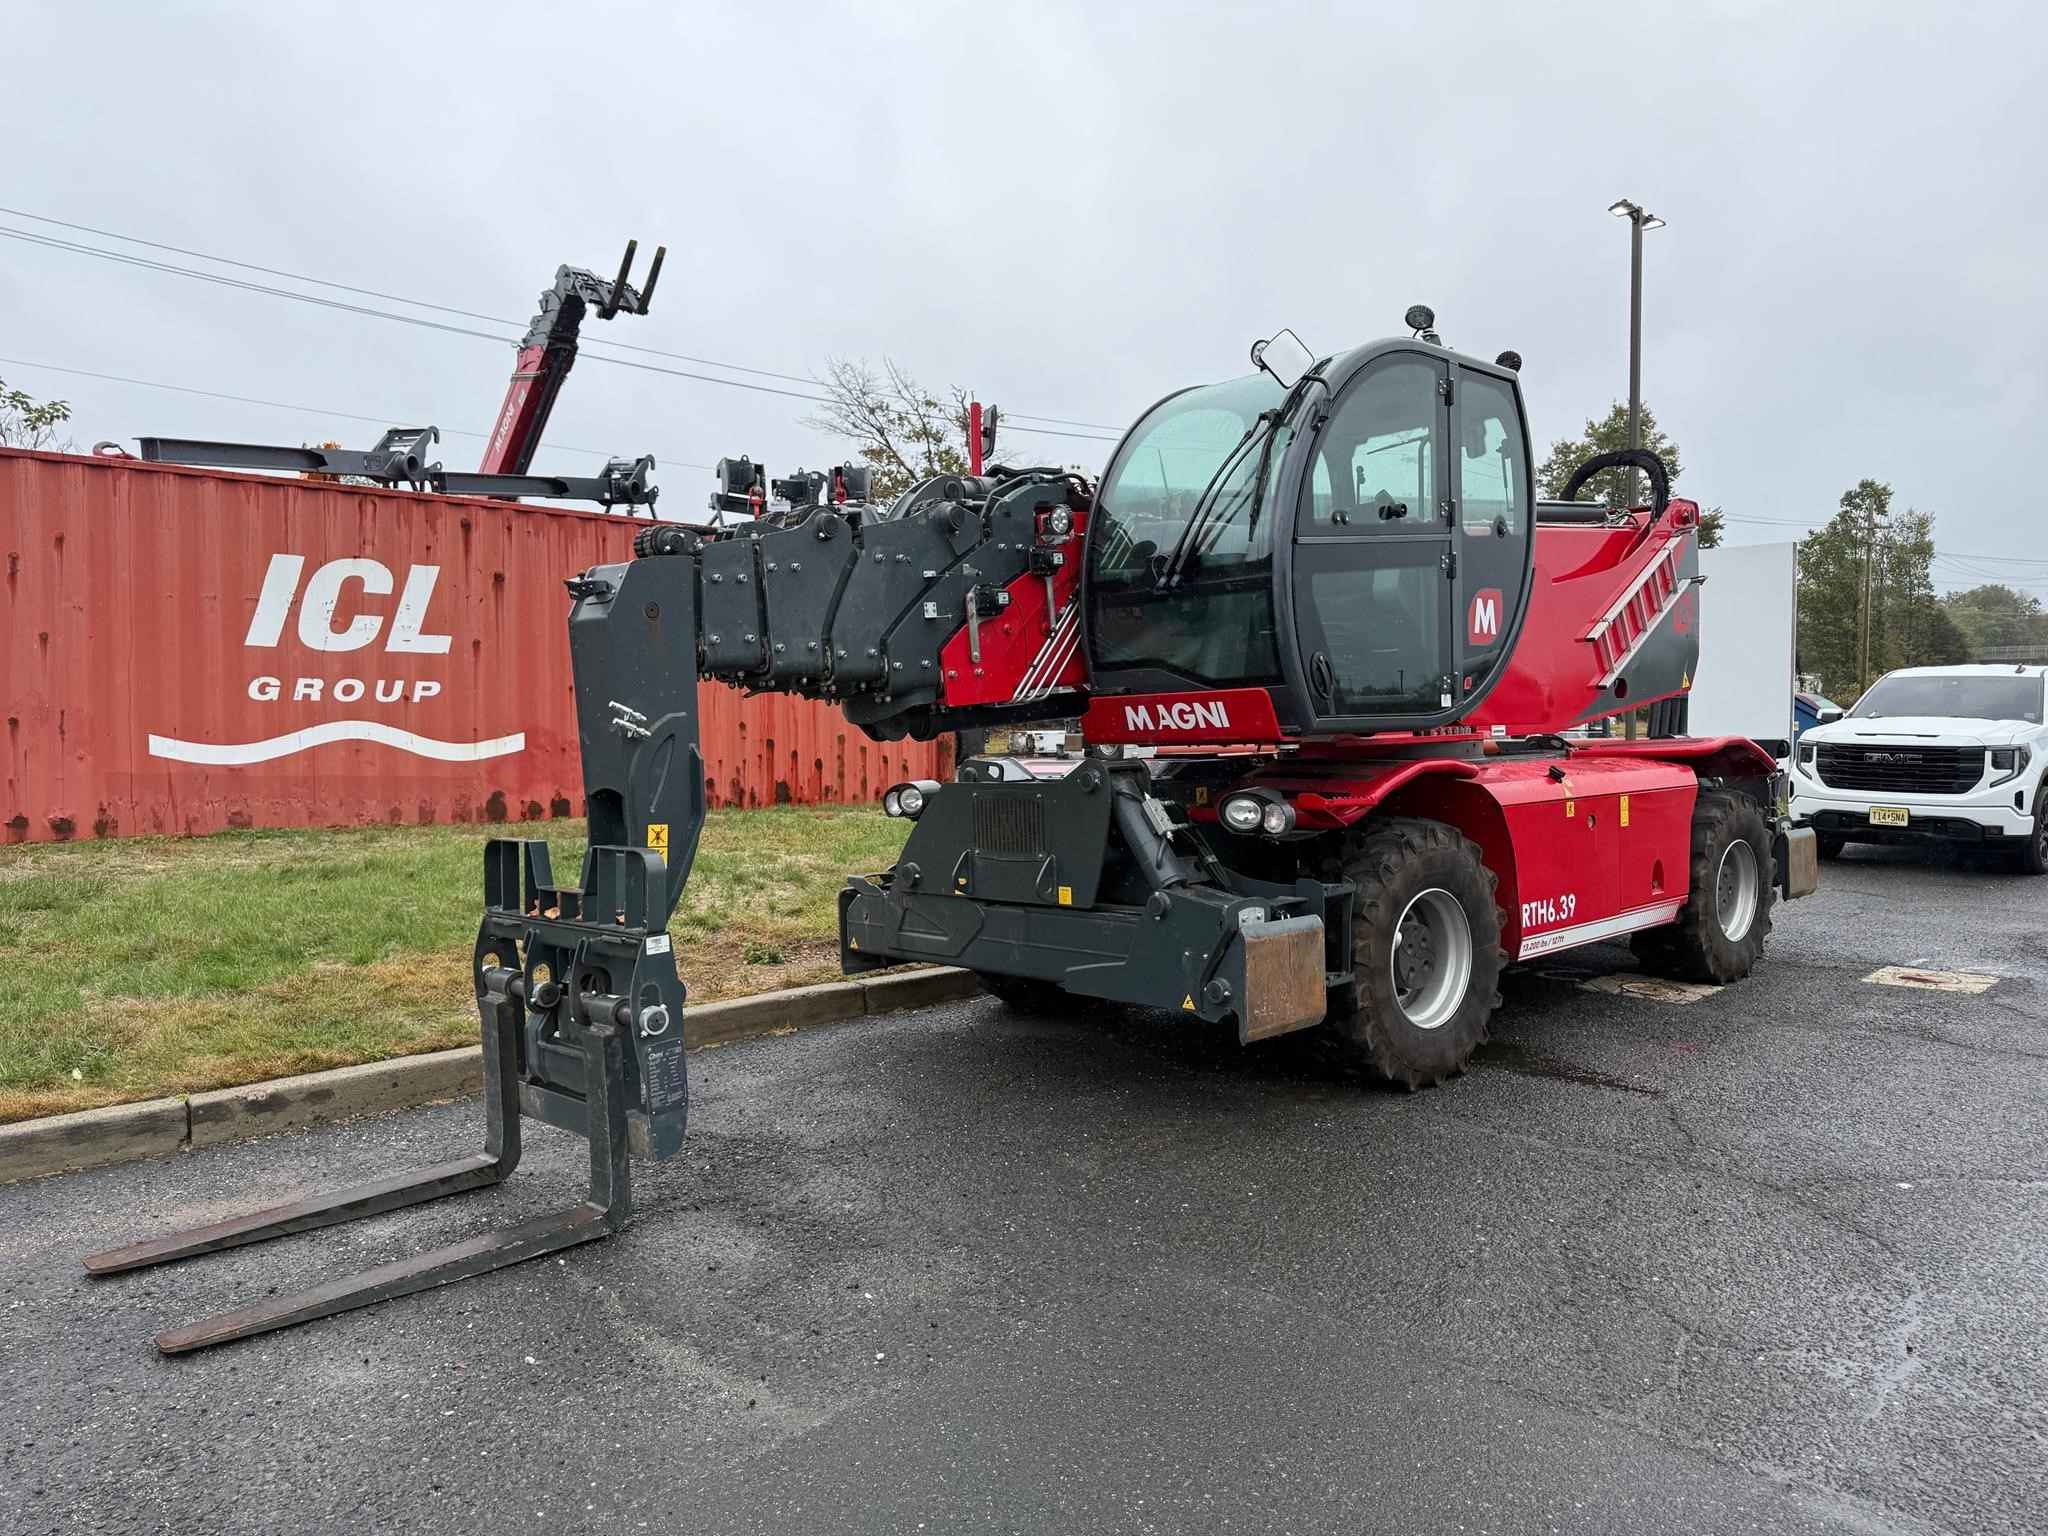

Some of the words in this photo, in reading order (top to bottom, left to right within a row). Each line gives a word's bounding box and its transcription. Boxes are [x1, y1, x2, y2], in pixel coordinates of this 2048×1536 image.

[495, 402, 515, 453] MAGNI
[244, 553, 453, 655] ICL
[1474, 598, 1497, 635] M
[247, 676, 441, 703] GROUP
[1124, 701, 1230, 731] MAGNI
[1863, 752, 1923, 764] GMC
[1522, 893, 1576, 928] RTH6.39
